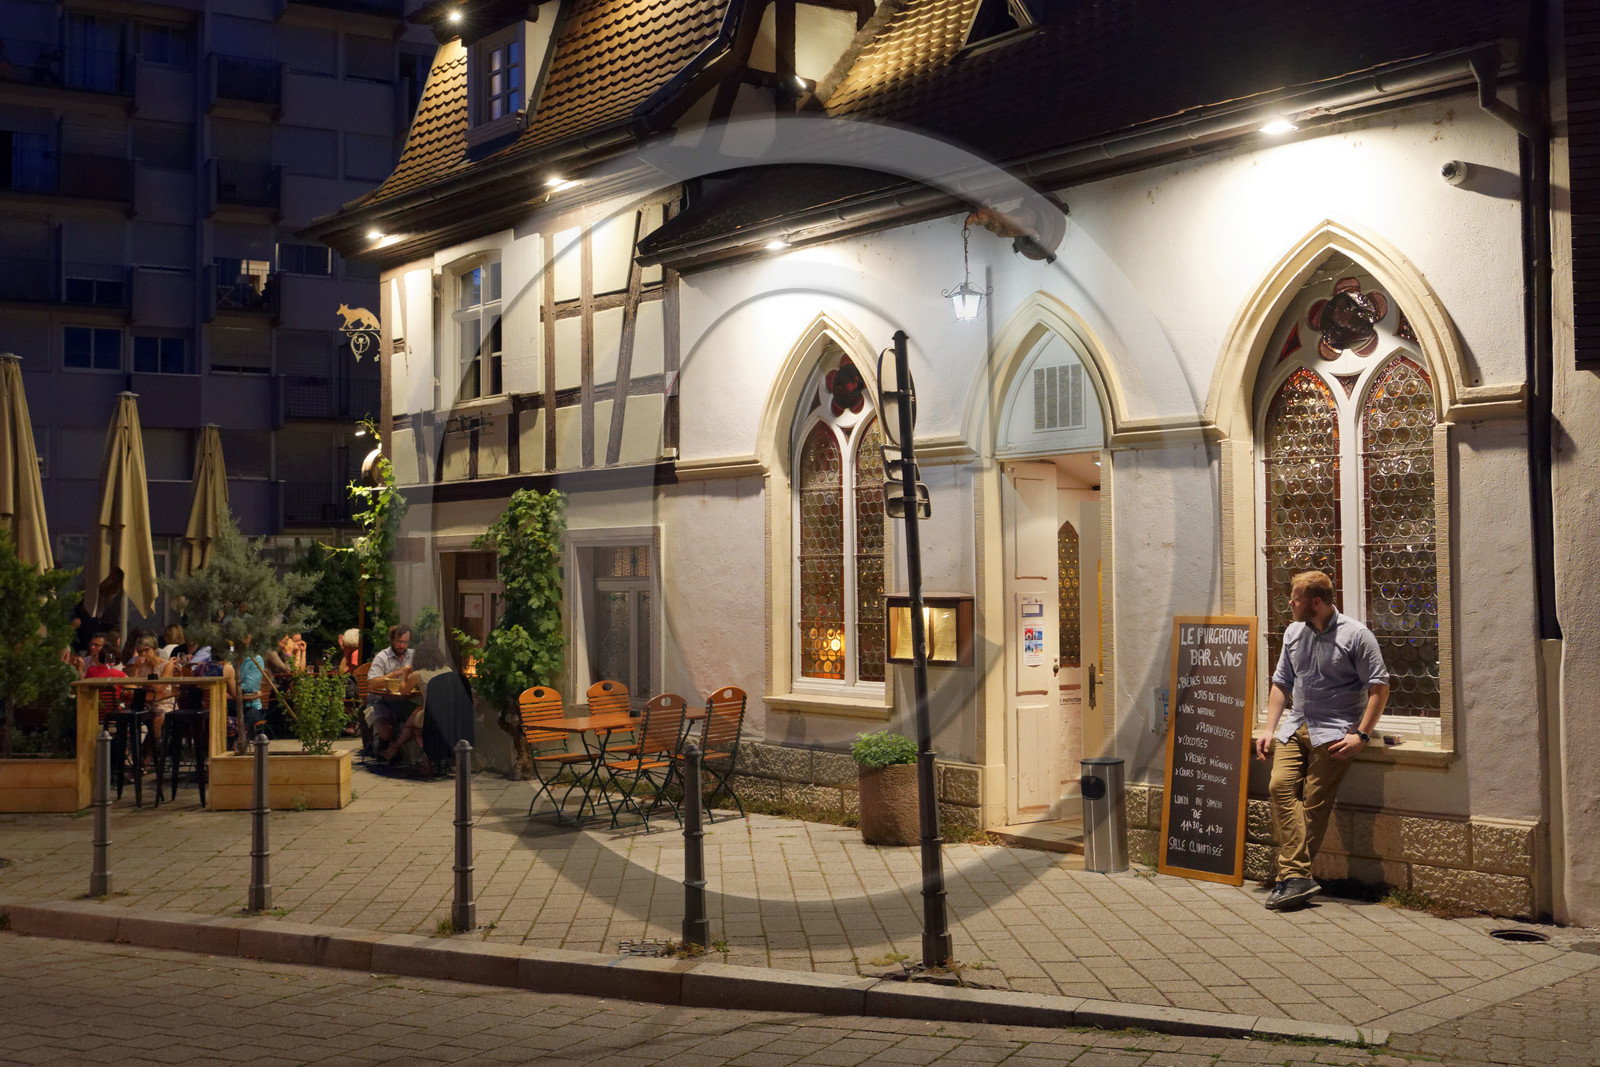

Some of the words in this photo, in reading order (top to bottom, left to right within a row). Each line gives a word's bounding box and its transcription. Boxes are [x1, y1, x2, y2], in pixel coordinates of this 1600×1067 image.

[1181, 628, 1194, 645] LE
[1198, 628, 1249, 644] PURGATOIRE
[1190, 649, 1211, 666] BAR
[1214, 656, 1221, 666] à
[1220, 646, 1242, 667] VINS
[1203, 675, 1227, 684] LOCALES
[1197, 690, 1207, 700] JUS
[1209, 692, 1215, 701] DE
[1217, 693, 1234, 704] FRUITS
[1235, 698, 1245, 707] BIO
[1182, 703, 1194, 714] VINS
[1198, 707, 1216, 717] NATURE
[1199, 722, 1236, 740] PLANCHETTES
[1183, 735, 1208, 748] COCOTTES
[1210, 756, 1233, 770] MIGNONS
[1179, 767, 1194, 777] COURS
[1174, 794, 1189, 805] LUNDI
[1195, 797, 1202, 806] AU
[1191, 809, 1202, 819] DE
[1199, 824, 1203, 833] à
[1169, 837, 1186, 851] SALLE
